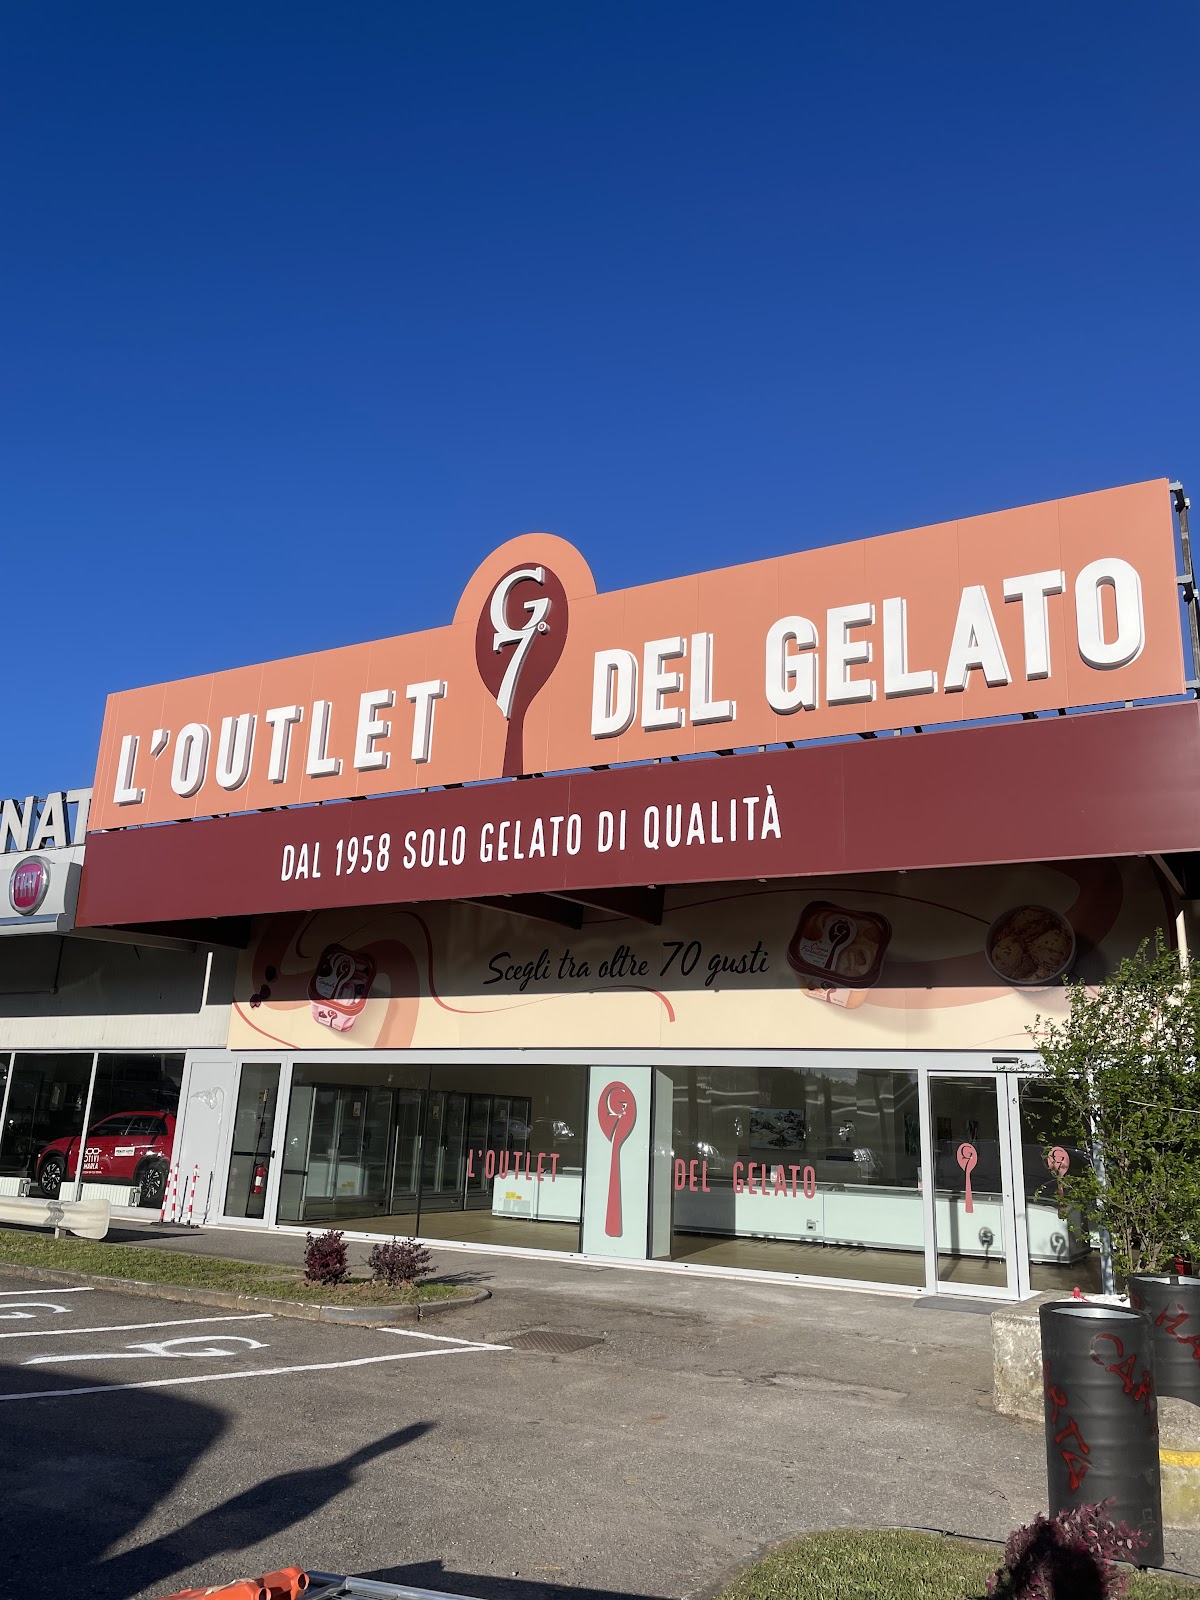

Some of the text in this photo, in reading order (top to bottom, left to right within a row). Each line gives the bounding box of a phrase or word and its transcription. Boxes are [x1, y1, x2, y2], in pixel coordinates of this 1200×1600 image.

[113, 557, 1145, 806] L'OUTLET DEL GELATO
[280, 784, 783, 882] DAL 1958 SOLO GELATO DI QUALITÀ
[15, 871, 41, 898] FIAT
[482, 940, 770, 992] Scegli tra oltre 70 gusti
[468, 1148, 816, 1199] L'OUTLET DEL GELATO
